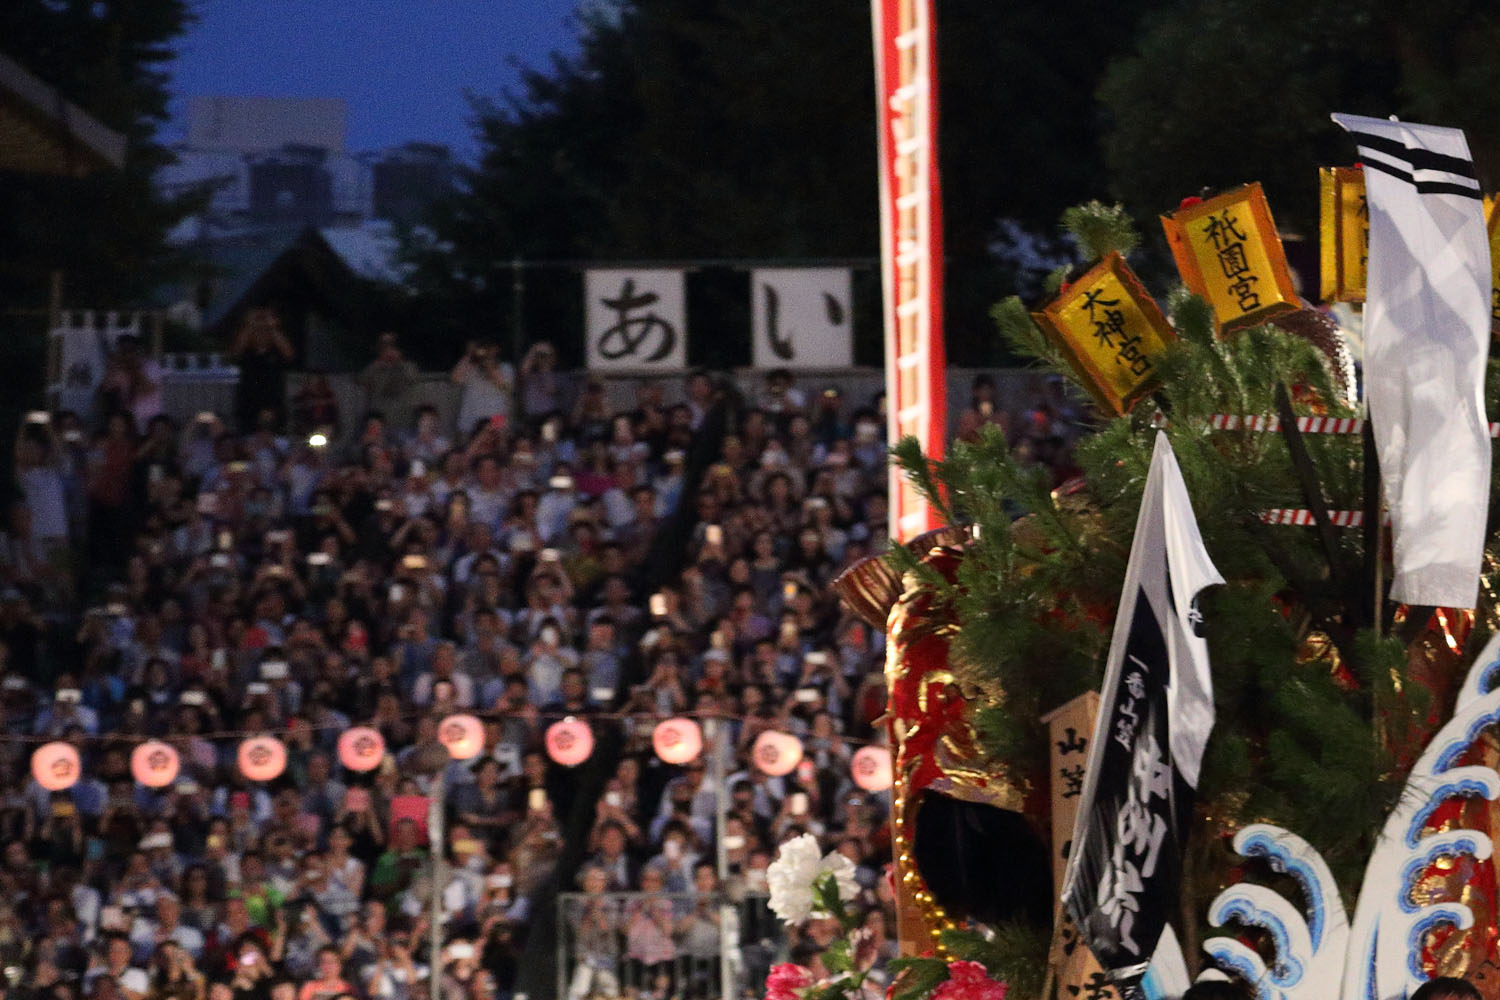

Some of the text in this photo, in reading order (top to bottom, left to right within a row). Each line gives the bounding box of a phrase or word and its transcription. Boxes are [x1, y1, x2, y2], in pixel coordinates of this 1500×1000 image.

[1202, 208, 1261, 312] 祇園宮
[598, 277, 677, 362] あ
[762, 281, 844, 361] い
[1081, 288, 1152, 376] 大神宮
